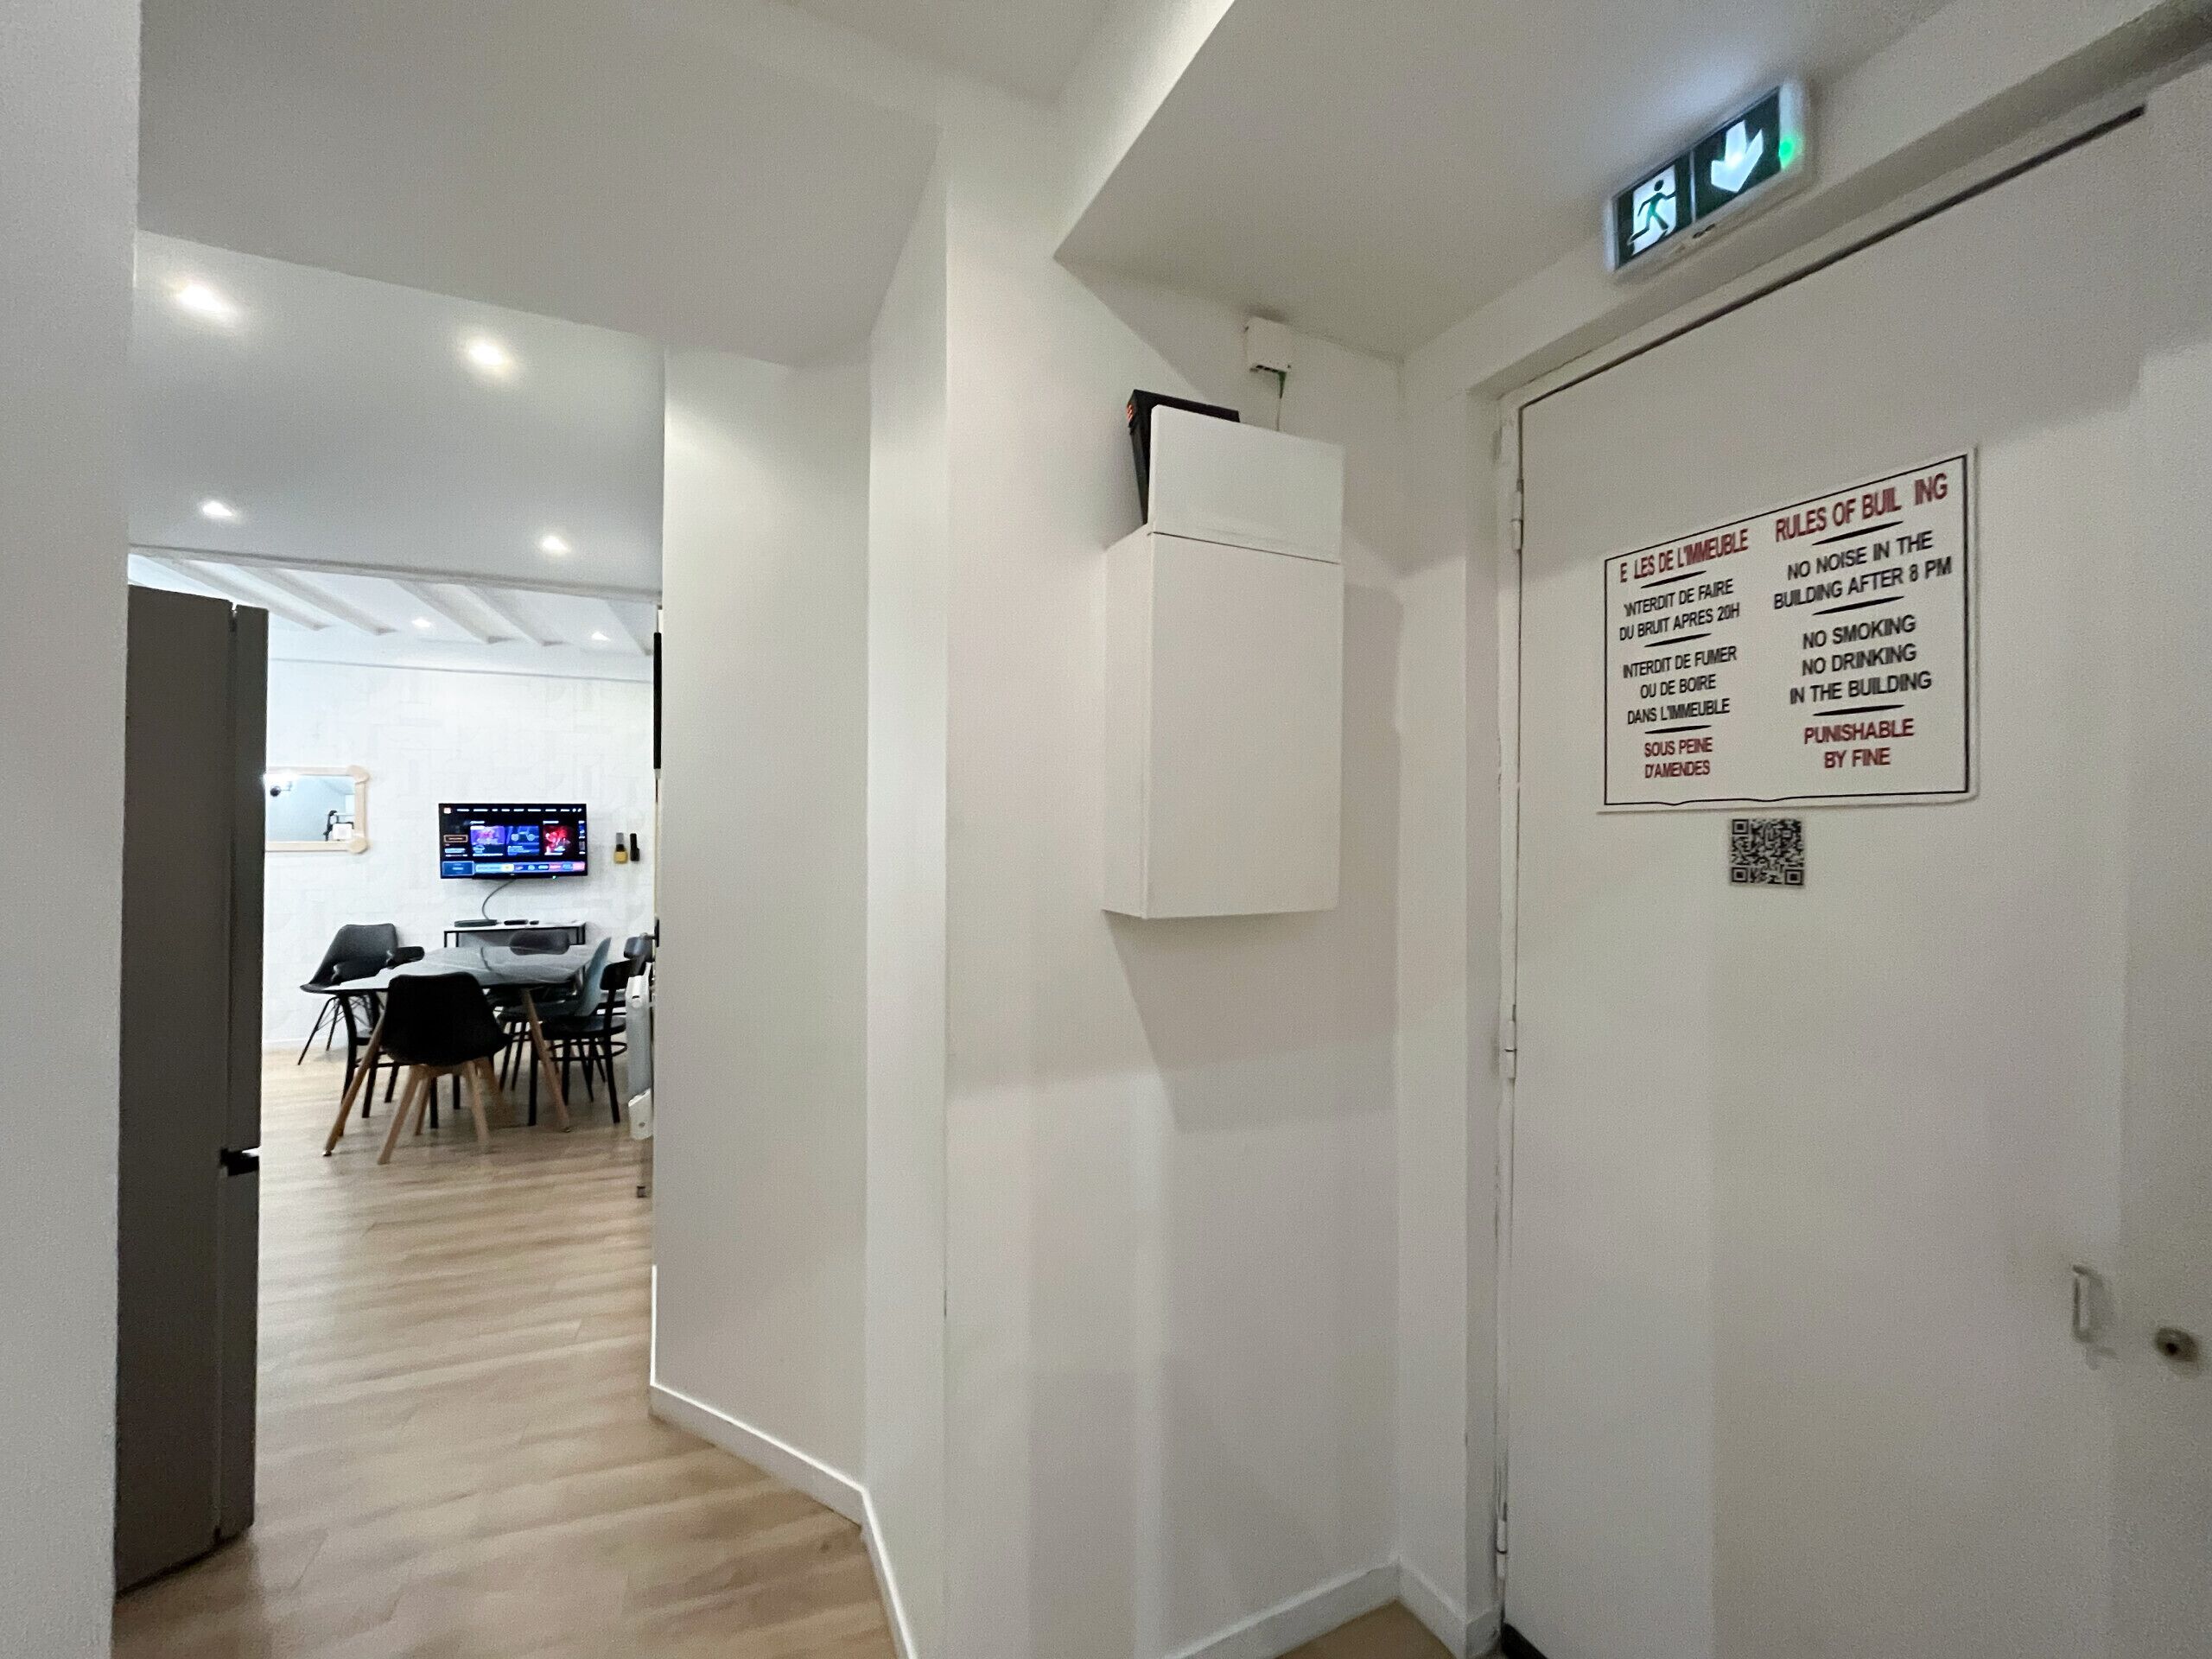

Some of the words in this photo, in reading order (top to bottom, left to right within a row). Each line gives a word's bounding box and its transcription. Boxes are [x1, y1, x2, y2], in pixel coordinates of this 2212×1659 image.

[1776, 507, 1827, 543] RULES
[1833, 499, 1856, 526] OF
[1862, 473, 1948, 519] BUILING
[1659, 550, 1673, 573] DE
[1677, 528, 1749, 568] L'IMMEUBLE
[1788, 561, 1811, 581] NO
[1816, 546, 1866, 574] NOISE
[1872, 541, 1890, 561] IN
[1897, 531, 1933, 556] THE
[1679, 588, 1694, 605] DE
[1698, 578, 1733, 601] FAIRE
[1774, 581, 1843, 609] BUILDING
[1847, 567, 1904, 595] AFTER
[1909, 563, 1919, 582] 8
[1924, 556, 1953, 580] PM
[1619, 624, 1635, 641] DU
[1637, 617, 1669, 638] BRUIT
[1673, 607, 1713, 631] APRES
[1717, 602, 1740, 621] 20H
[1802, 630, 1827, 650] NO
[1832, 614, 1916, 645] SMOKING
[1623, 657, 1672, 678] INTERDIT
[1675, 653, 1691, 671] DE
[1694, 645, 1737, 667] FUMER
[1802, 657, 1826, 676] NO
[1831, 643, 1916, 672] DRINKING
[1641, 684, 1656, 699] OU
[1660, 680, 1675, 696] DE
[1679, 674, 1716, 694] BOIRE
[1789, 687, 1805, 704] IN
[1810, 682, 1842, 702] THE
[1848, 671, 1932, 697] BUILDING
[1628, 707, 1657, 725] DANS
[1661, 697, 1730, 721] L'IMMEUBLE
[1644, 741, 1675, 757] SOUS
[1679, 737, 1713, 754] PEINE
[1804, 718, 1915, 744] PUNISHABLE
[1644, 760, 1710, 779] D'AMENDES
[1824, 750, 1847, 768] BY
[1852, 747, 1891, 767] FINE
